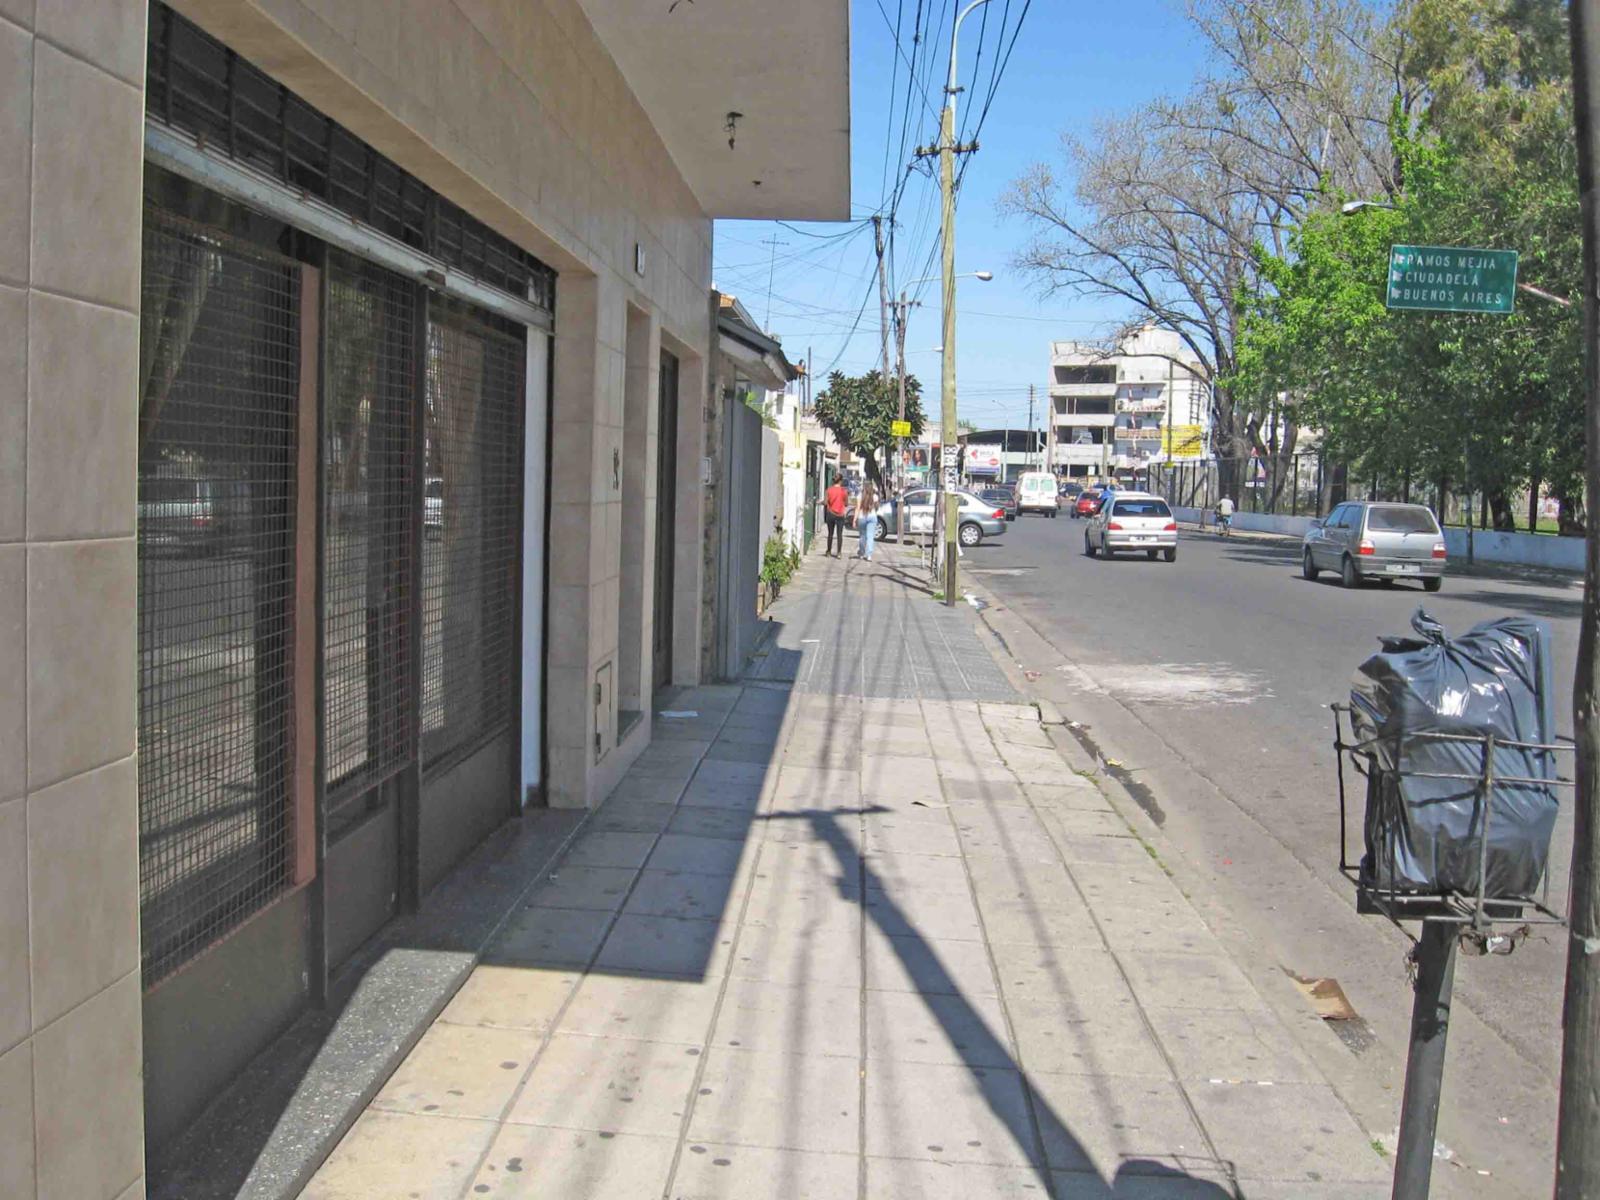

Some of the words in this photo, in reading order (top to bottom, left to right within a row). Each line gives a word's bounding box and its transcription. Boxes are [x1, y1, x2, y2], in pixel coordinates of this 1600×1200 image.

[1407, 253, 1451, 267] RAMOS
[1458, 256, 1496, 269] MEJIA
[1405, 271, 1479, 286] CIUDADELA
[1403, 288, 1455, 301] BUENOS
[1462, 292, 1502, 304] AIRES
